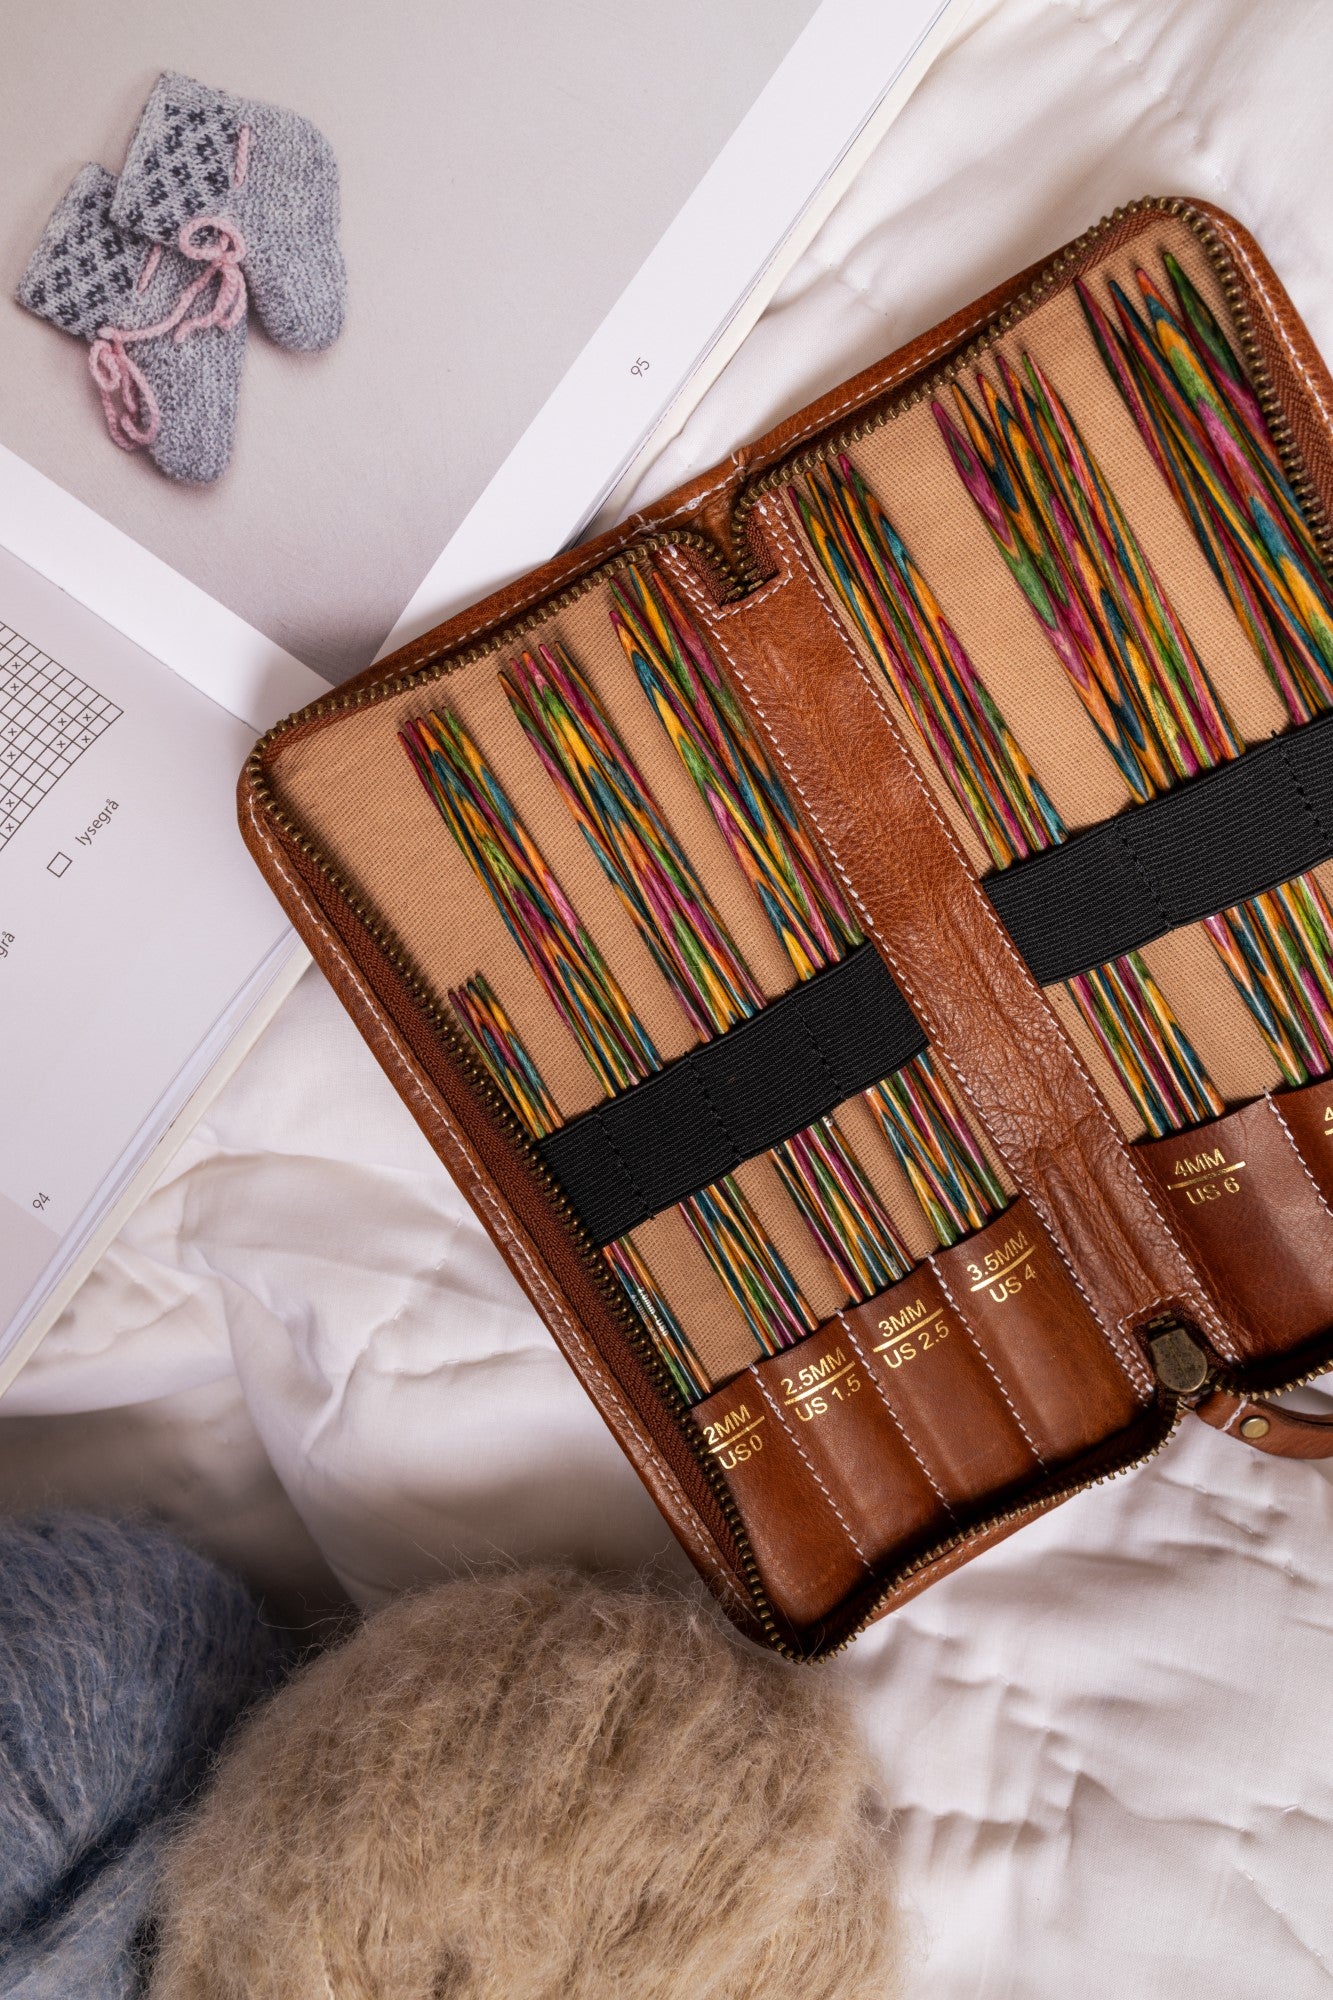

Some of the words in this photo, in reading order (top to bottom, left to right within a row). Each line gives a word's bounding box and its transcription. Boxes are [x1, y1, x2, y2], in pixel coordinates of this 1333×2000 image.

[631, 357, 650, 378] 95
[75, 798, 120, 846] lysegrå
[1174, 1148, 1226, 1177] 4MM
[32, 1192, 51, 1211] 94
[1186, 1184, 1222, 1205] US
[1224, 1177, 1240, 1194] 6
[966, 1230, 1028, 1281] 3.5MM
[989, 1276, 1023, 1303] US
[1024, 1263, 1037, 1280] 4
[878, 1298, 927, 1338] 3MM
[882, 1342, 917, 1369] US
[918, 1320, 949, 1351] 2.5
[780, 1347, 848, 1395] 2.5MM
[795, 1396, 829, 1422] US
[831, 1373, 861, 1402] 1.5
[703, 1404, 752, 1446] 2MM
